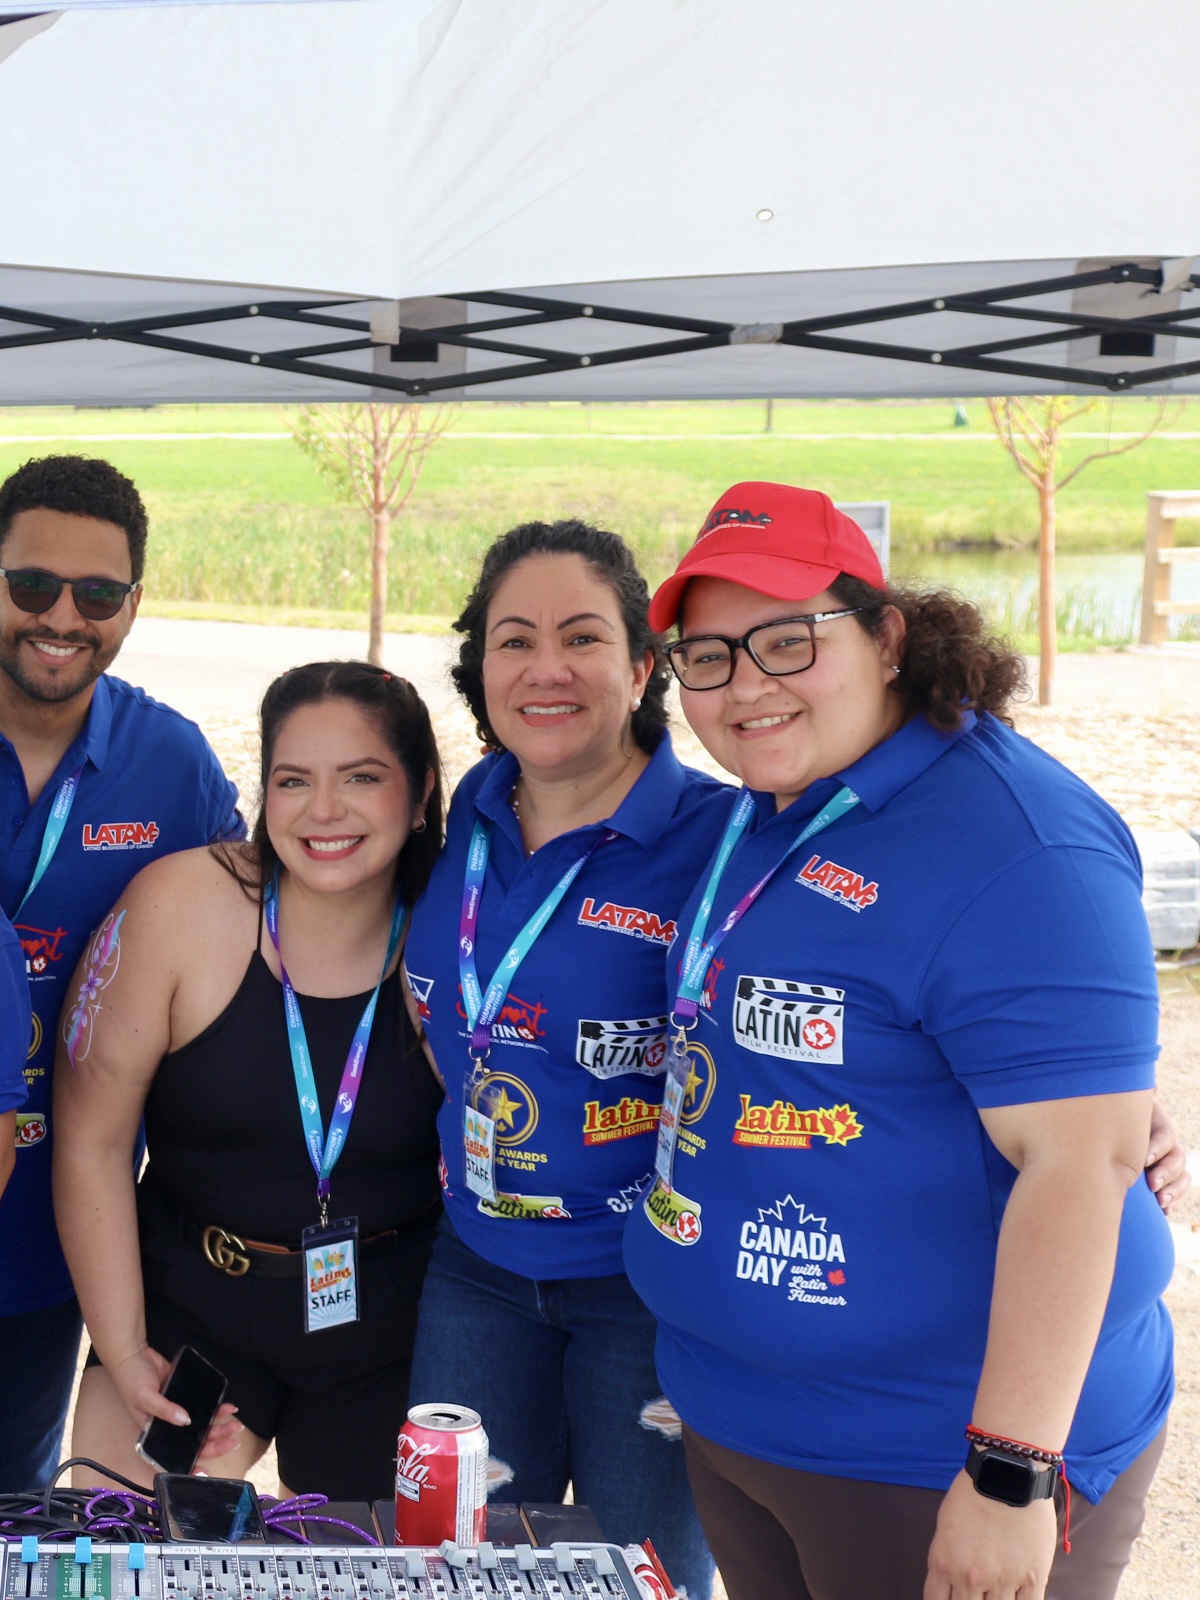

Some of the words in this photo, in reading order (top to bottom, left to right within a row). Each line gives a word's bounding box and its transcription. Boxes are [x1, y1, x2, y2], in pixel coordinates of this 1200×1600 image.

[83, 822, 156, 846] LATAM
[798, 855, 876, 909] LATAM
[578, 920, 598, 928] LATINO
[599, 924, 634, 937] BUSINESSES
[480, 986, 497, 1025] CHAMPION
[501, 1039, 524, 1047] NETWORK
[742, 1036, 763, 1048] FILM
[767, 1043, 823, 1059] FESTIVAL
[591, 1129, 622, 1143] SUMMER
[623, 1121, 654, 1136] FESTIVAL
[739, 1132, 769, 1145] SUMMER
[770, 1133, 808, 1147] FESTIVAL
[500, 1148, 548, 1163] AWARDS
[677, 1139, 697, 1157] YEAR
[467, 1158, 489, 1183] STAFF
[507, 1160, 536, 1171] YEAR
[740, 1221, 846, 1263] CANADA
[736, 1250, 788, 1286] DAY
[790, 1263, 823, 1276] with
[788, 1276, 828, 1290] Latin
[311, 1290, 351, 1310] STAFF
[787, 1288, 847, 1306] Flavour
